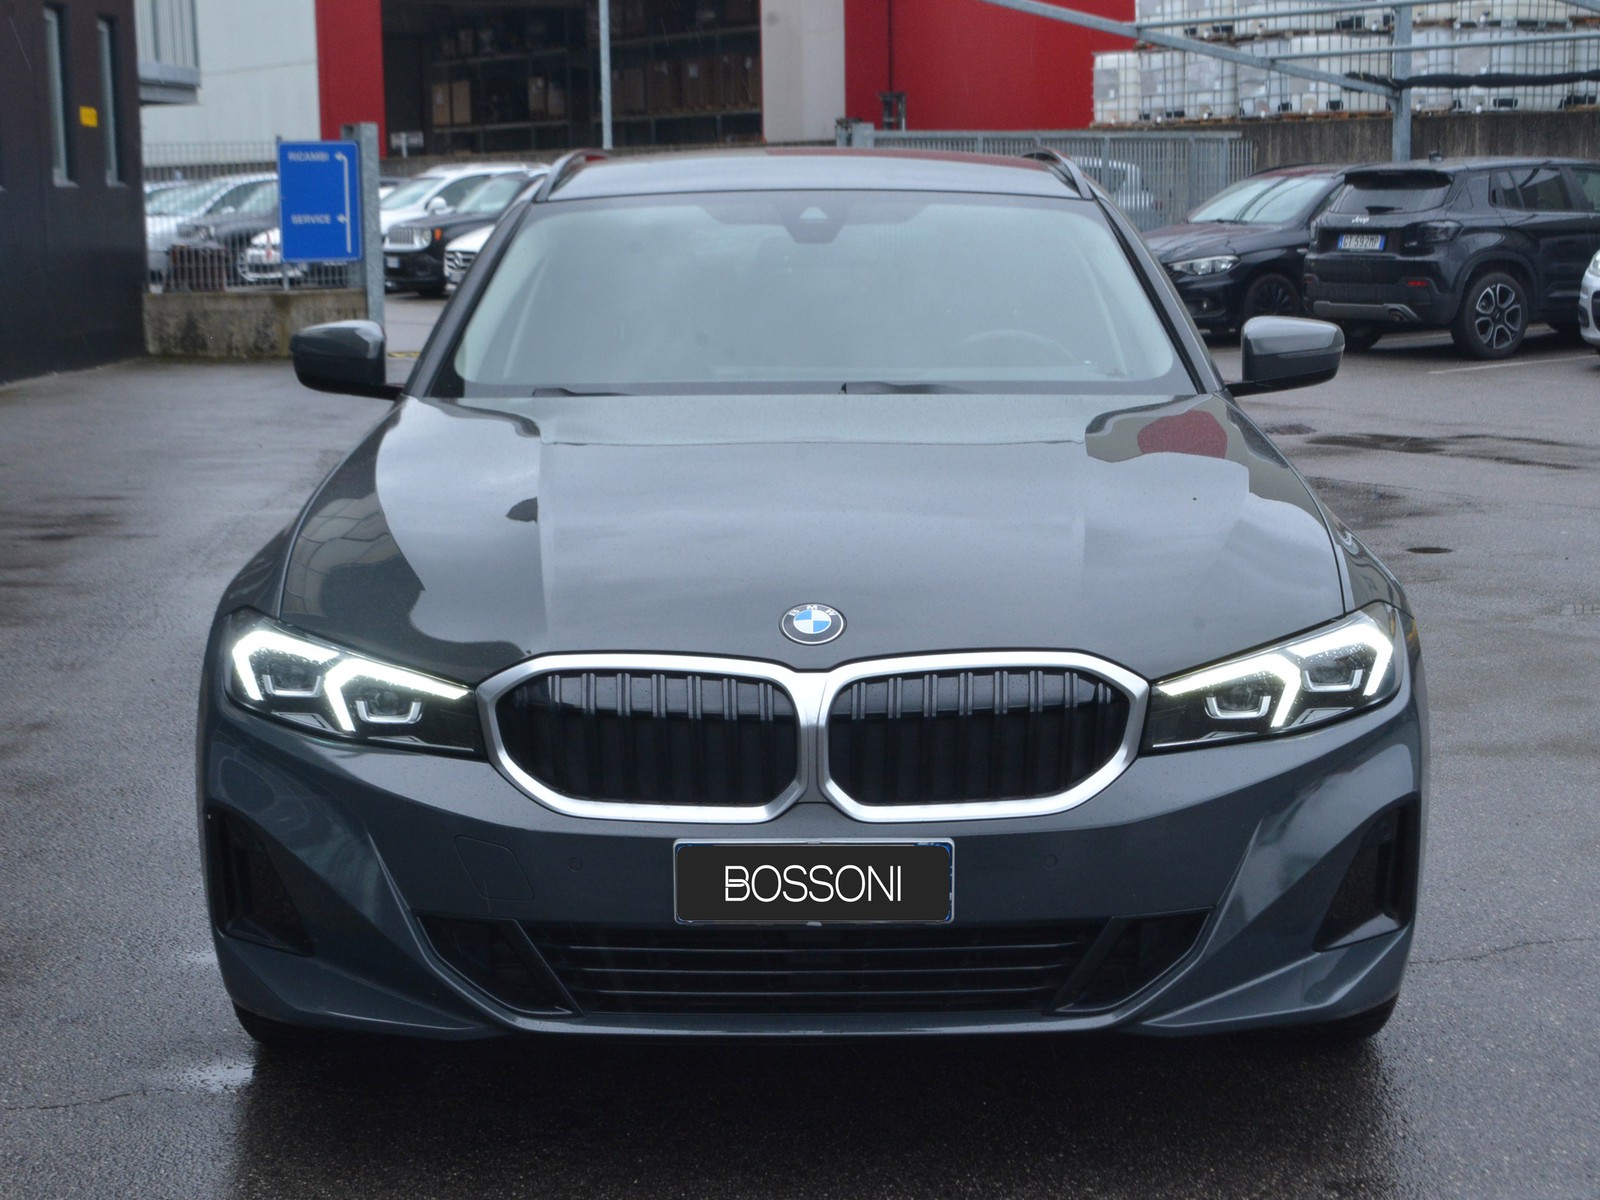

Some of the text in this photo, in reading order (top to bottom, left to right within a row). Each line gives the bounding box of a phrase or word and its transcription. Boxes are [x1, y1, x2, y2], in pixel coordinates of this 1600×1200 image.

[287, 151, 330, 162] RICAMBI
[291, 214, 331, 225] SERVICE
[789, 604, 838, 616] BMW
